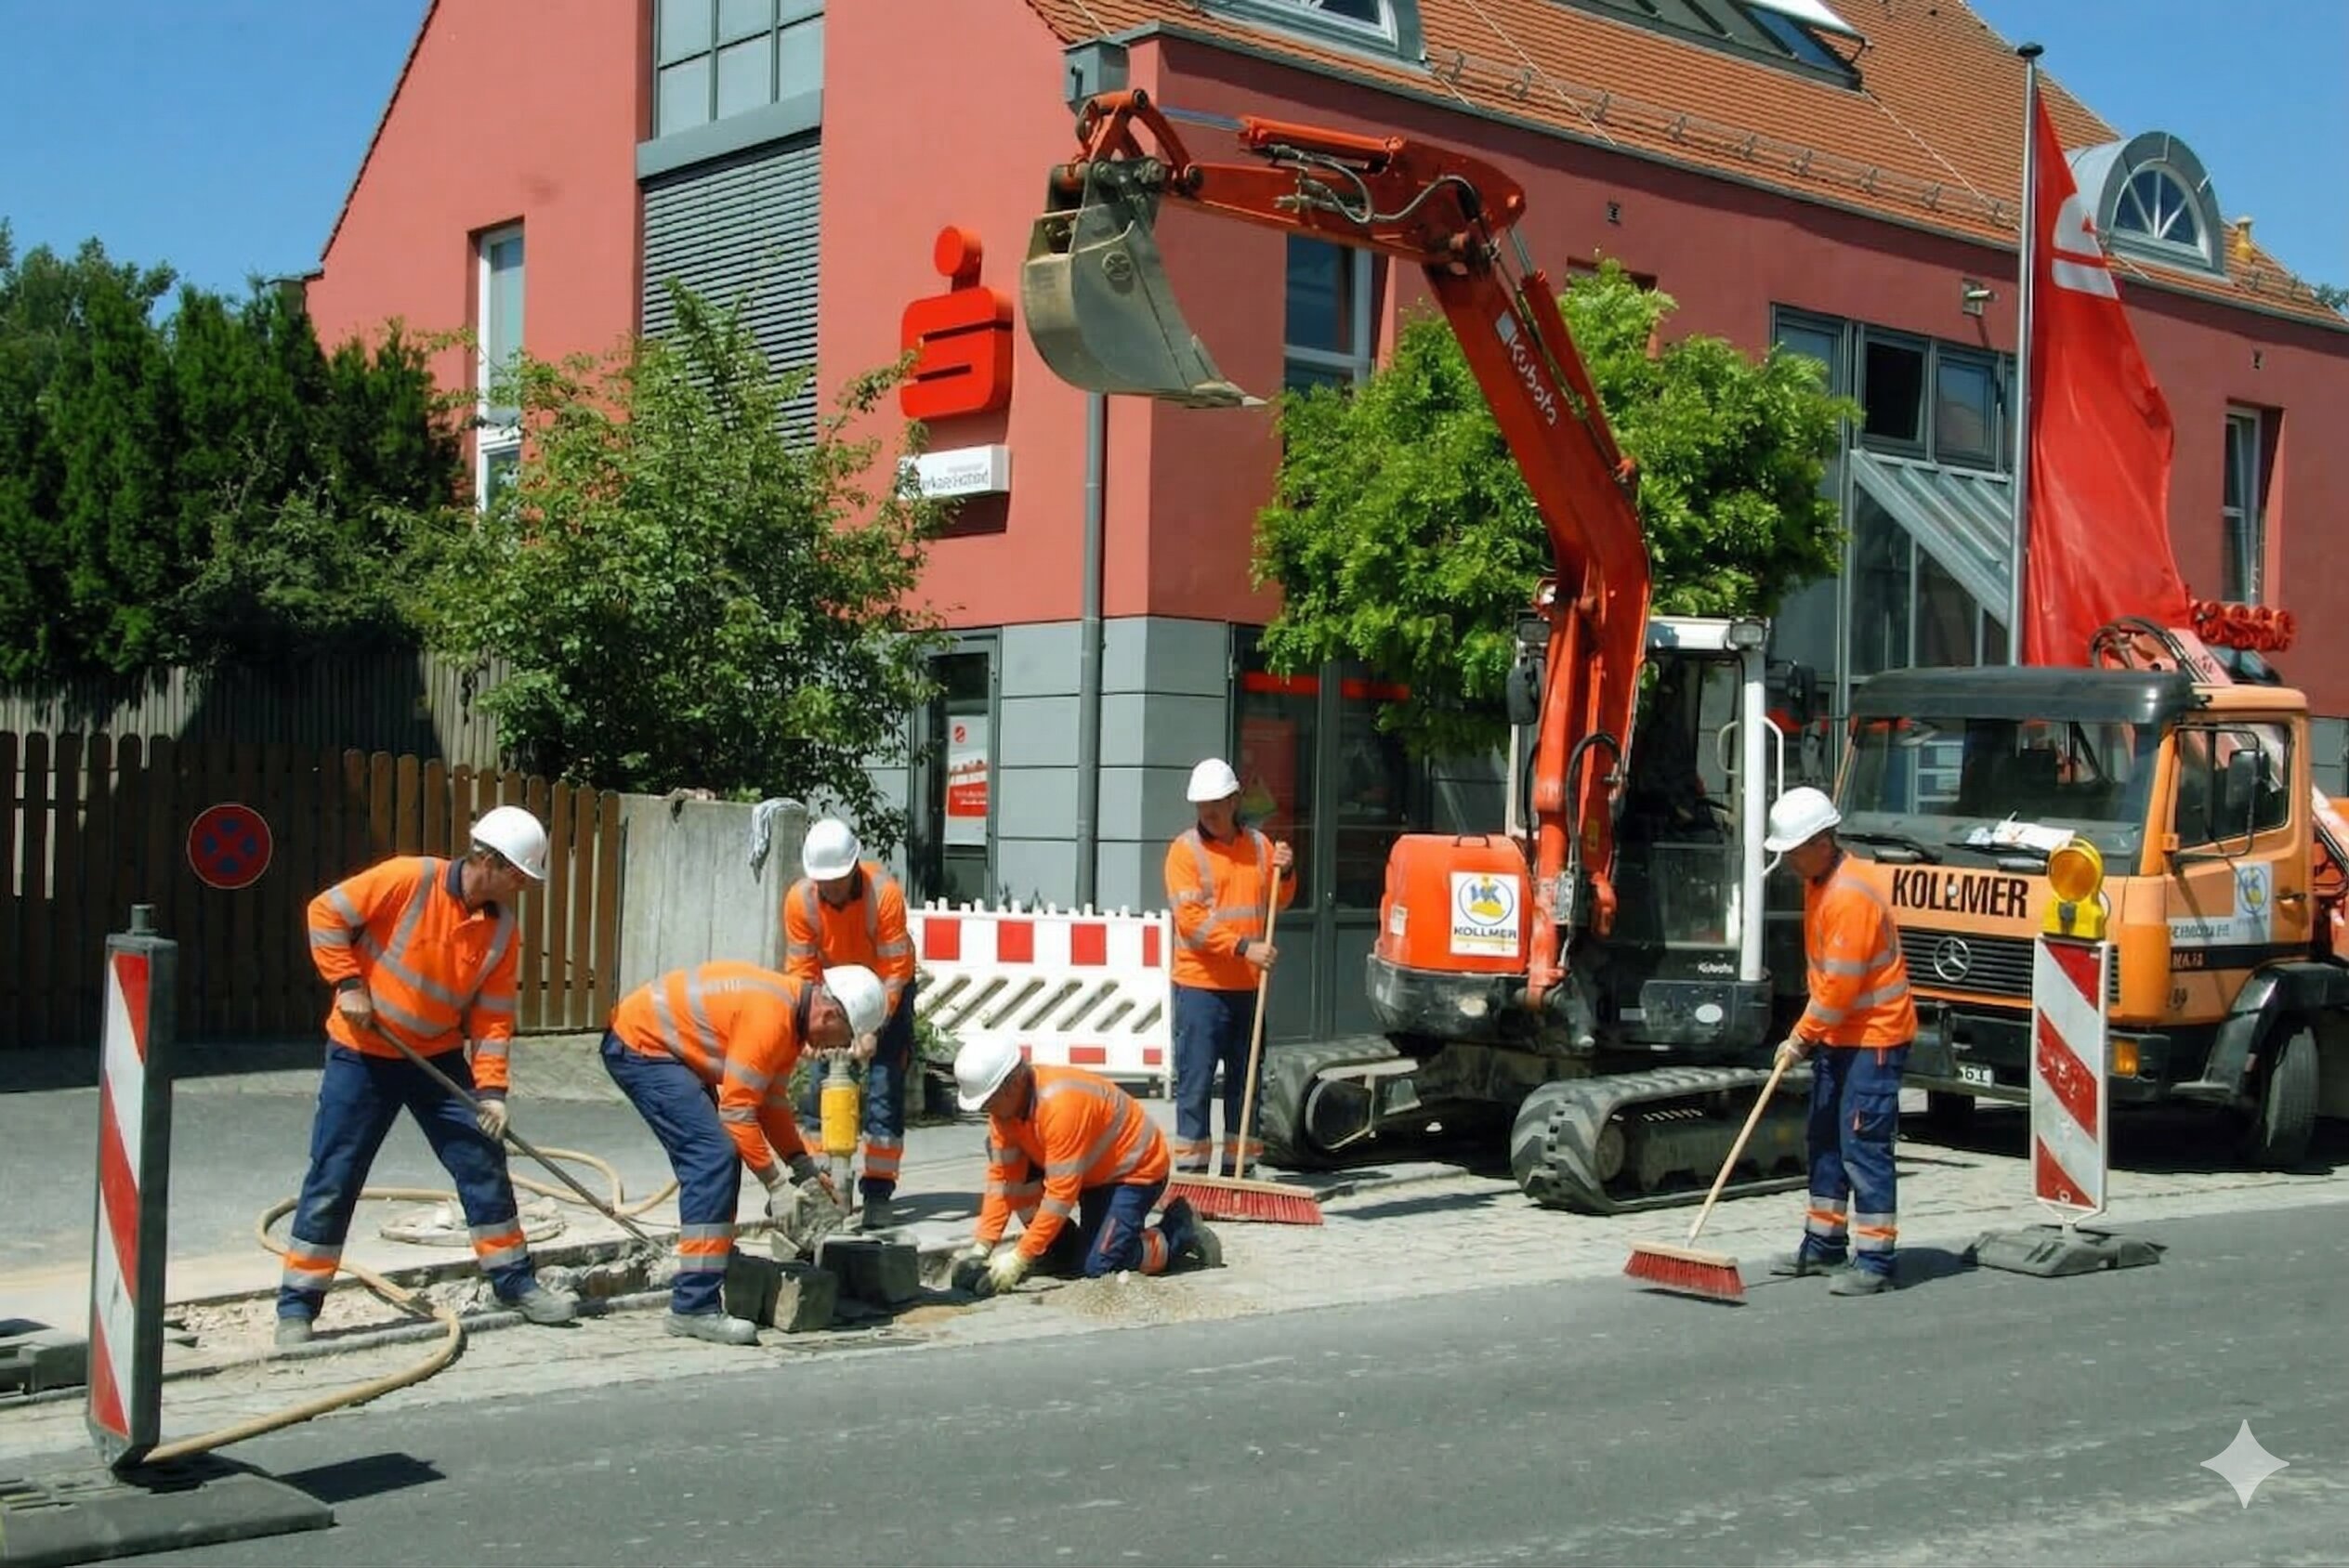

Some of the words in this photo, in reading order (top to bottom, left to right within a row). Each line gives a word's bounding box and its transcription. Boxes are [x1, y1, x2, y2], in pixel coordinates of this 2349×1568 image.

[1508, 332, 1558, 427] Kubota
[1892, 868, 2029, 919] KOLLMER
[1453, 926, 1517, 939] KOLLMER
